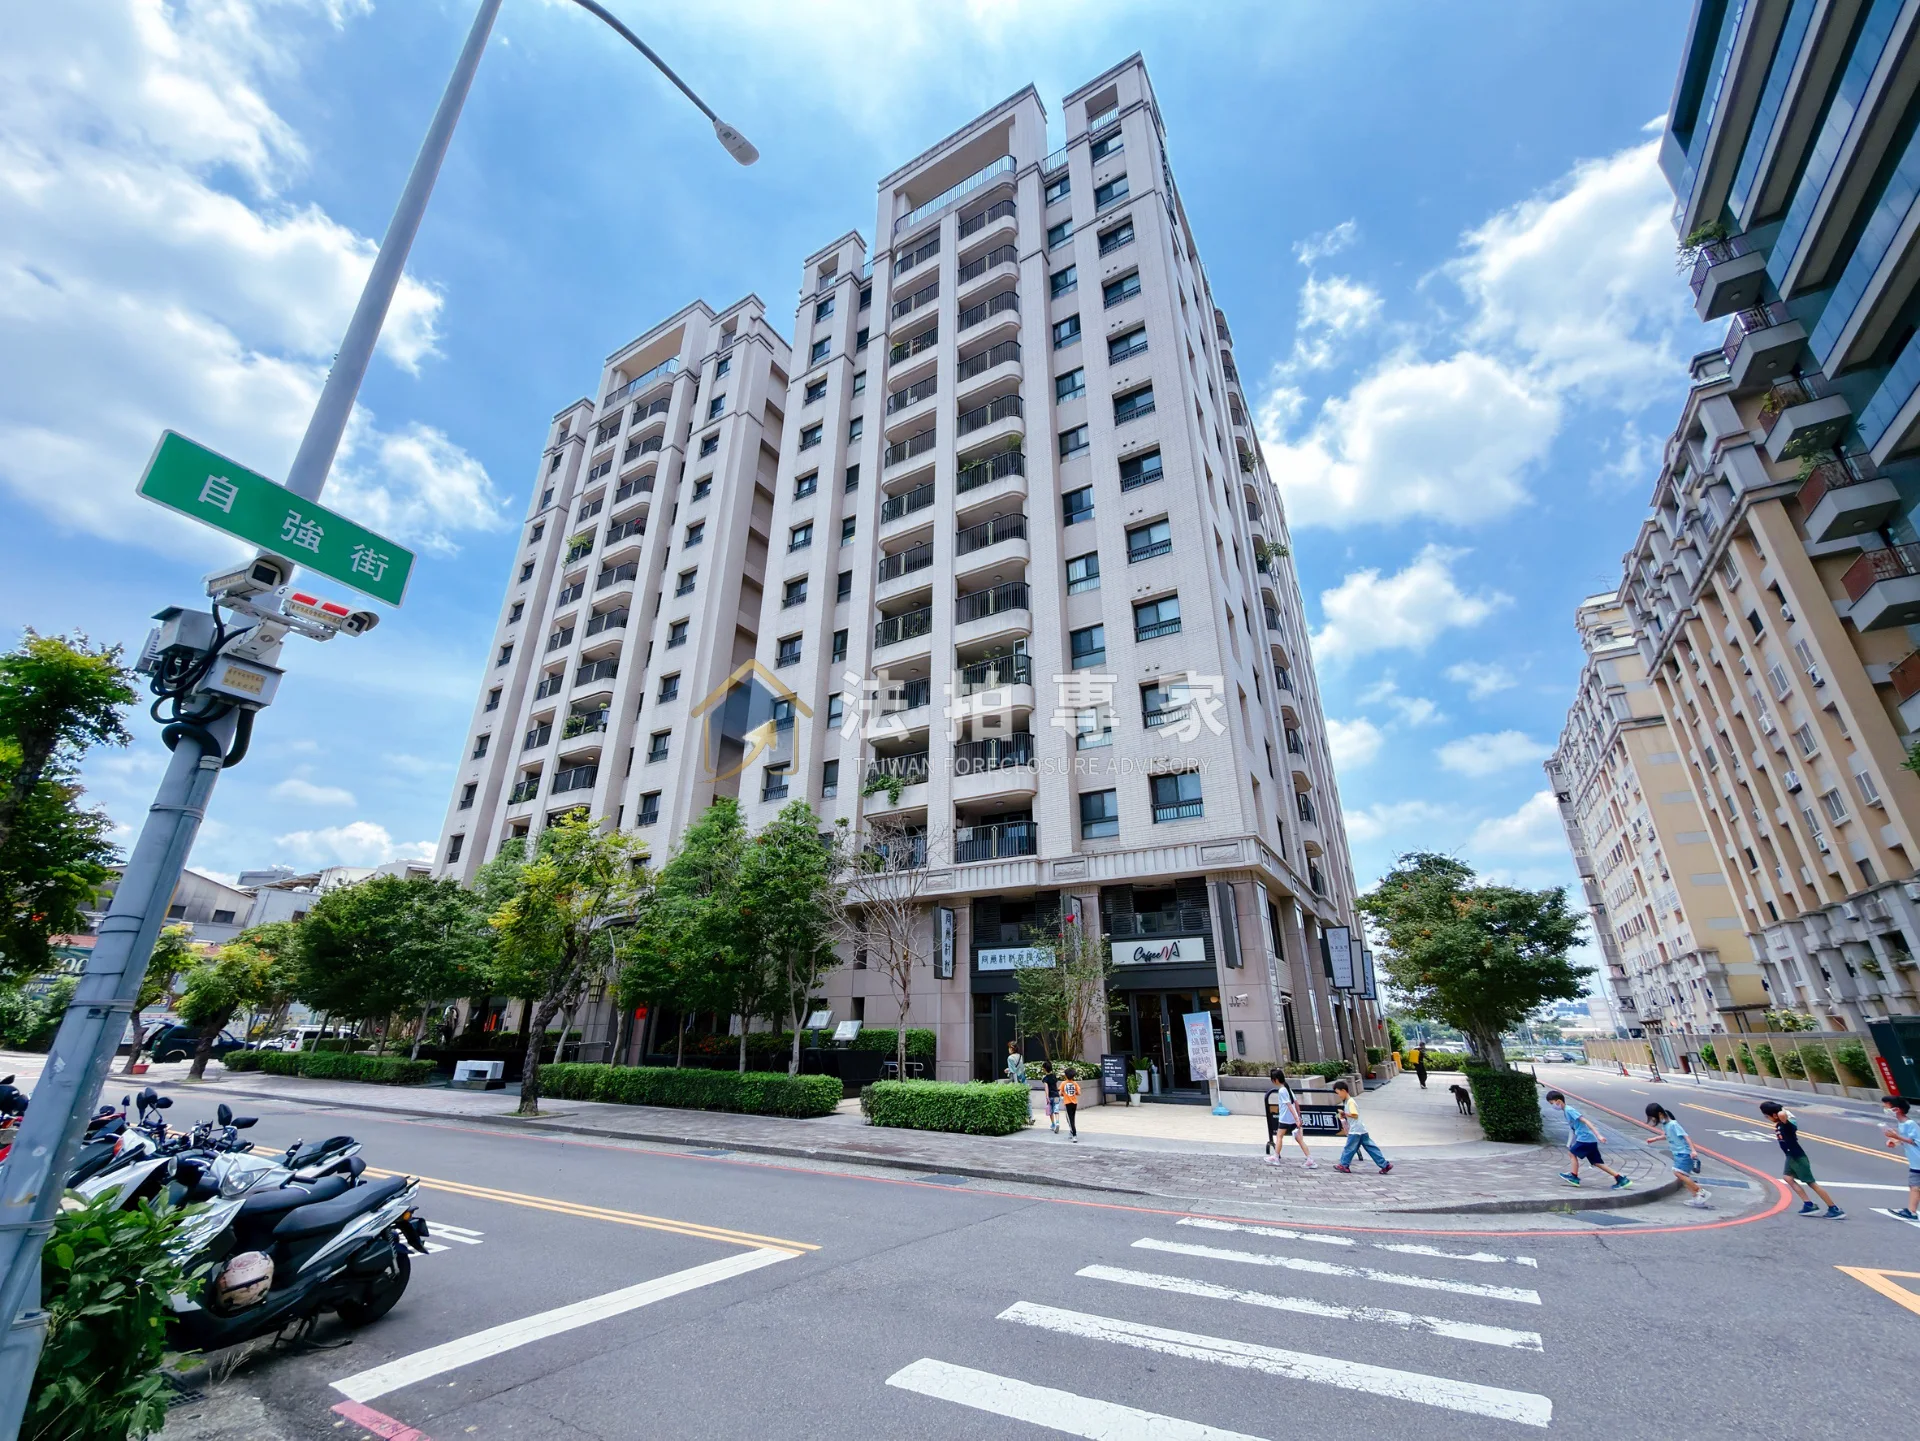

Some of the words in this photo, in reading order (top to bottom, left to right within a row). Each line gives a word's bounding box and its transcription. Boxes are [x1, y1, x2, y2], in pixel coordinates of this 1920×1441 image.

[198, 474, 389, 582] 自強街
[1066, 1084, 1076, 1096] 悟
